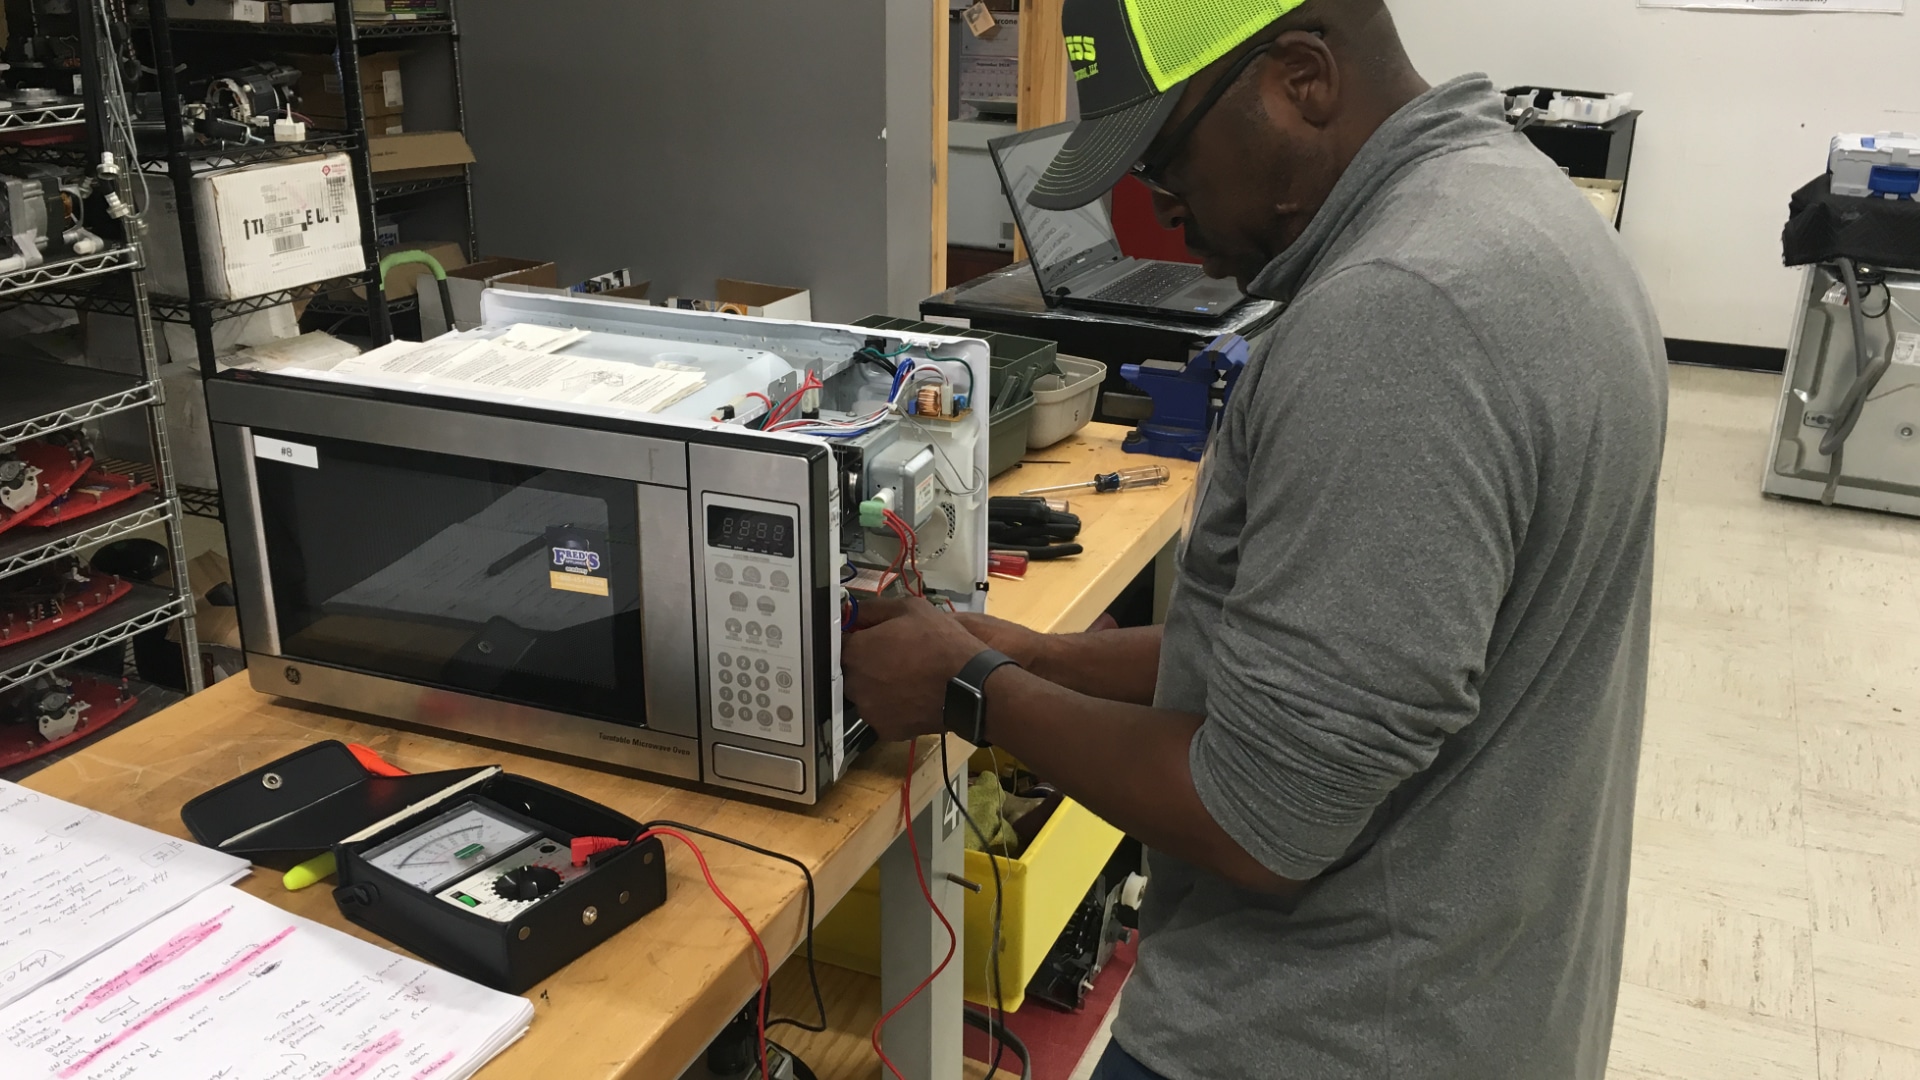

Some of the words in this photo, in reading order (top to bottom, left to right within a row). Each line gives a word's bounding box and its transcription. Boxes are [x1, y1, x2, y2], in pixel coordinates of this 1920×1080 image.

[552, 547, 600, 570] FRED'S
[599, 732, 631, 744] Turntable
[632, 738, 671, 752] Microwave
[673, 746, 691, 756] Oven
[944, 779, 957, 830] 4
